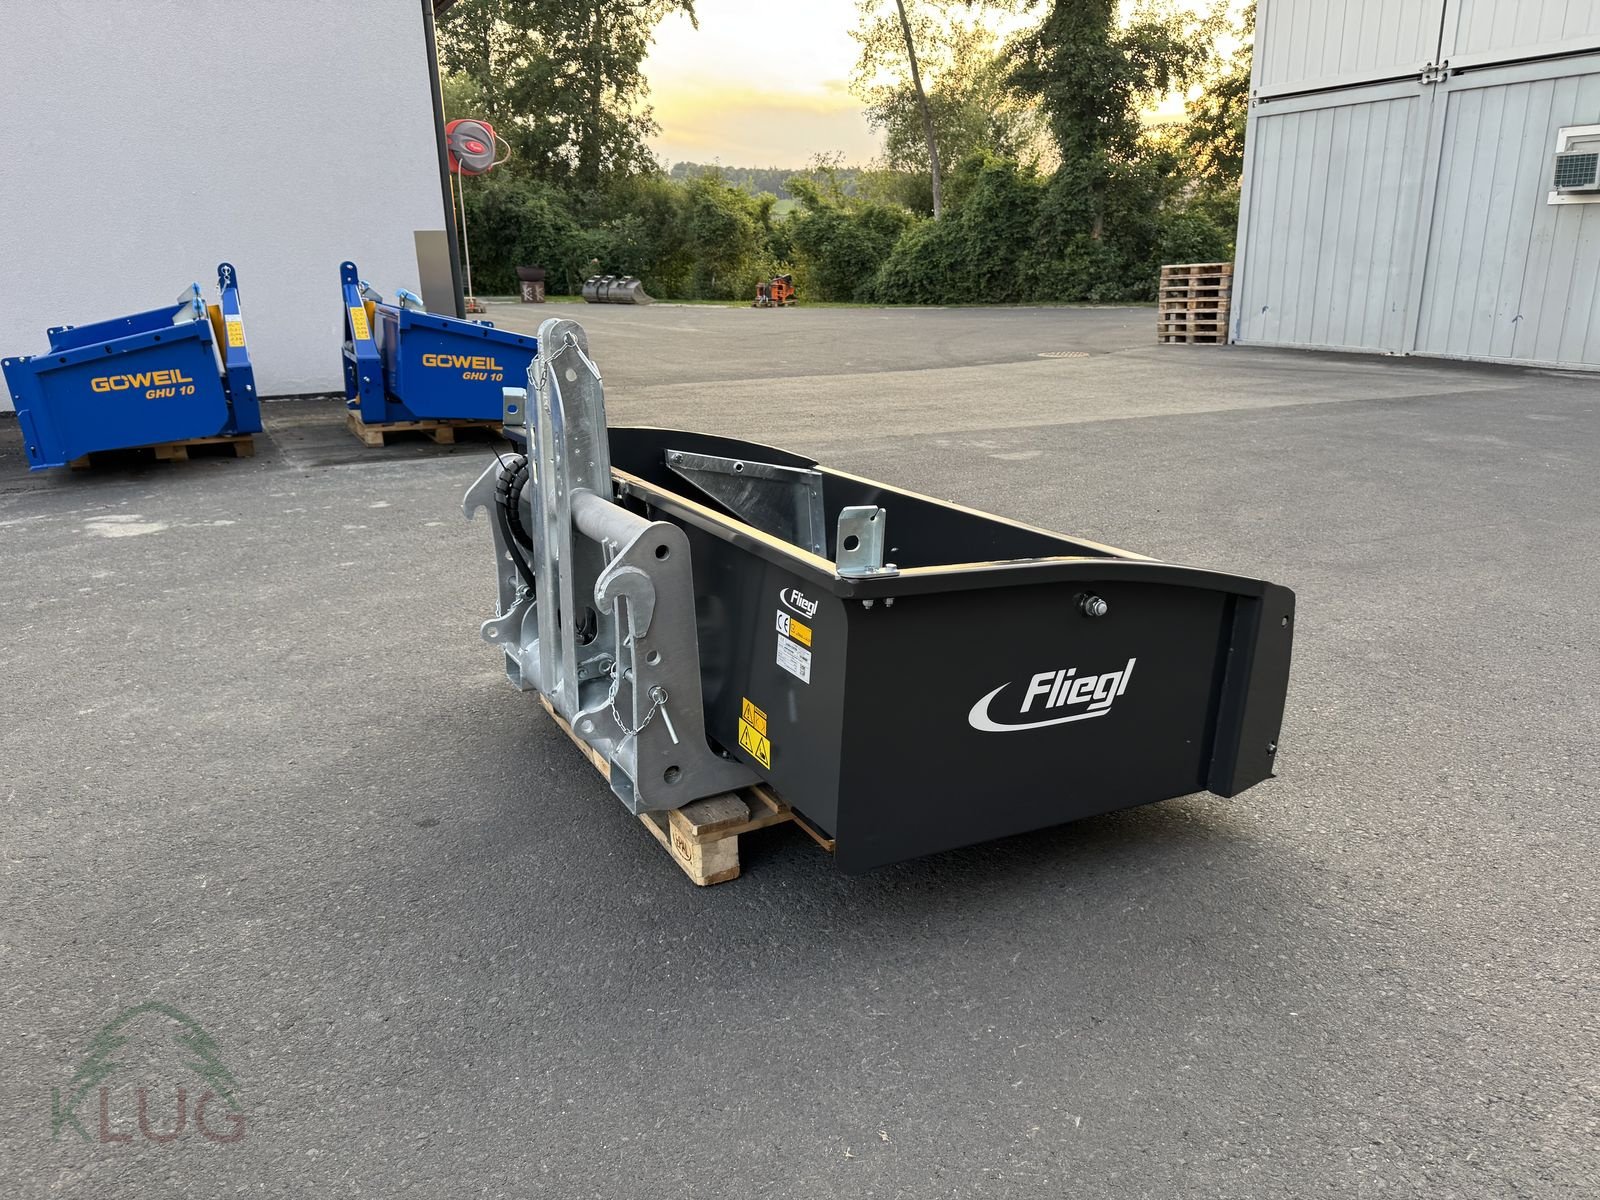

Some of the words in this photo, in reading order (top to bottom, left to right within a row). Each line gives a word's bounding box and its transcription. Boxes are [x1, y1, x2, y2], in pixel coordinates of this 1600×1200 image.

[462, 371, 488, 381] GHU
[490, 373, 503, 382] 10
[146, 387, 176, 399] GHU
[180, 385, 195, 395] 10
[790, 589, 819, 616] Fliegl
[1019, 657, 1137, 711] Fliegl
